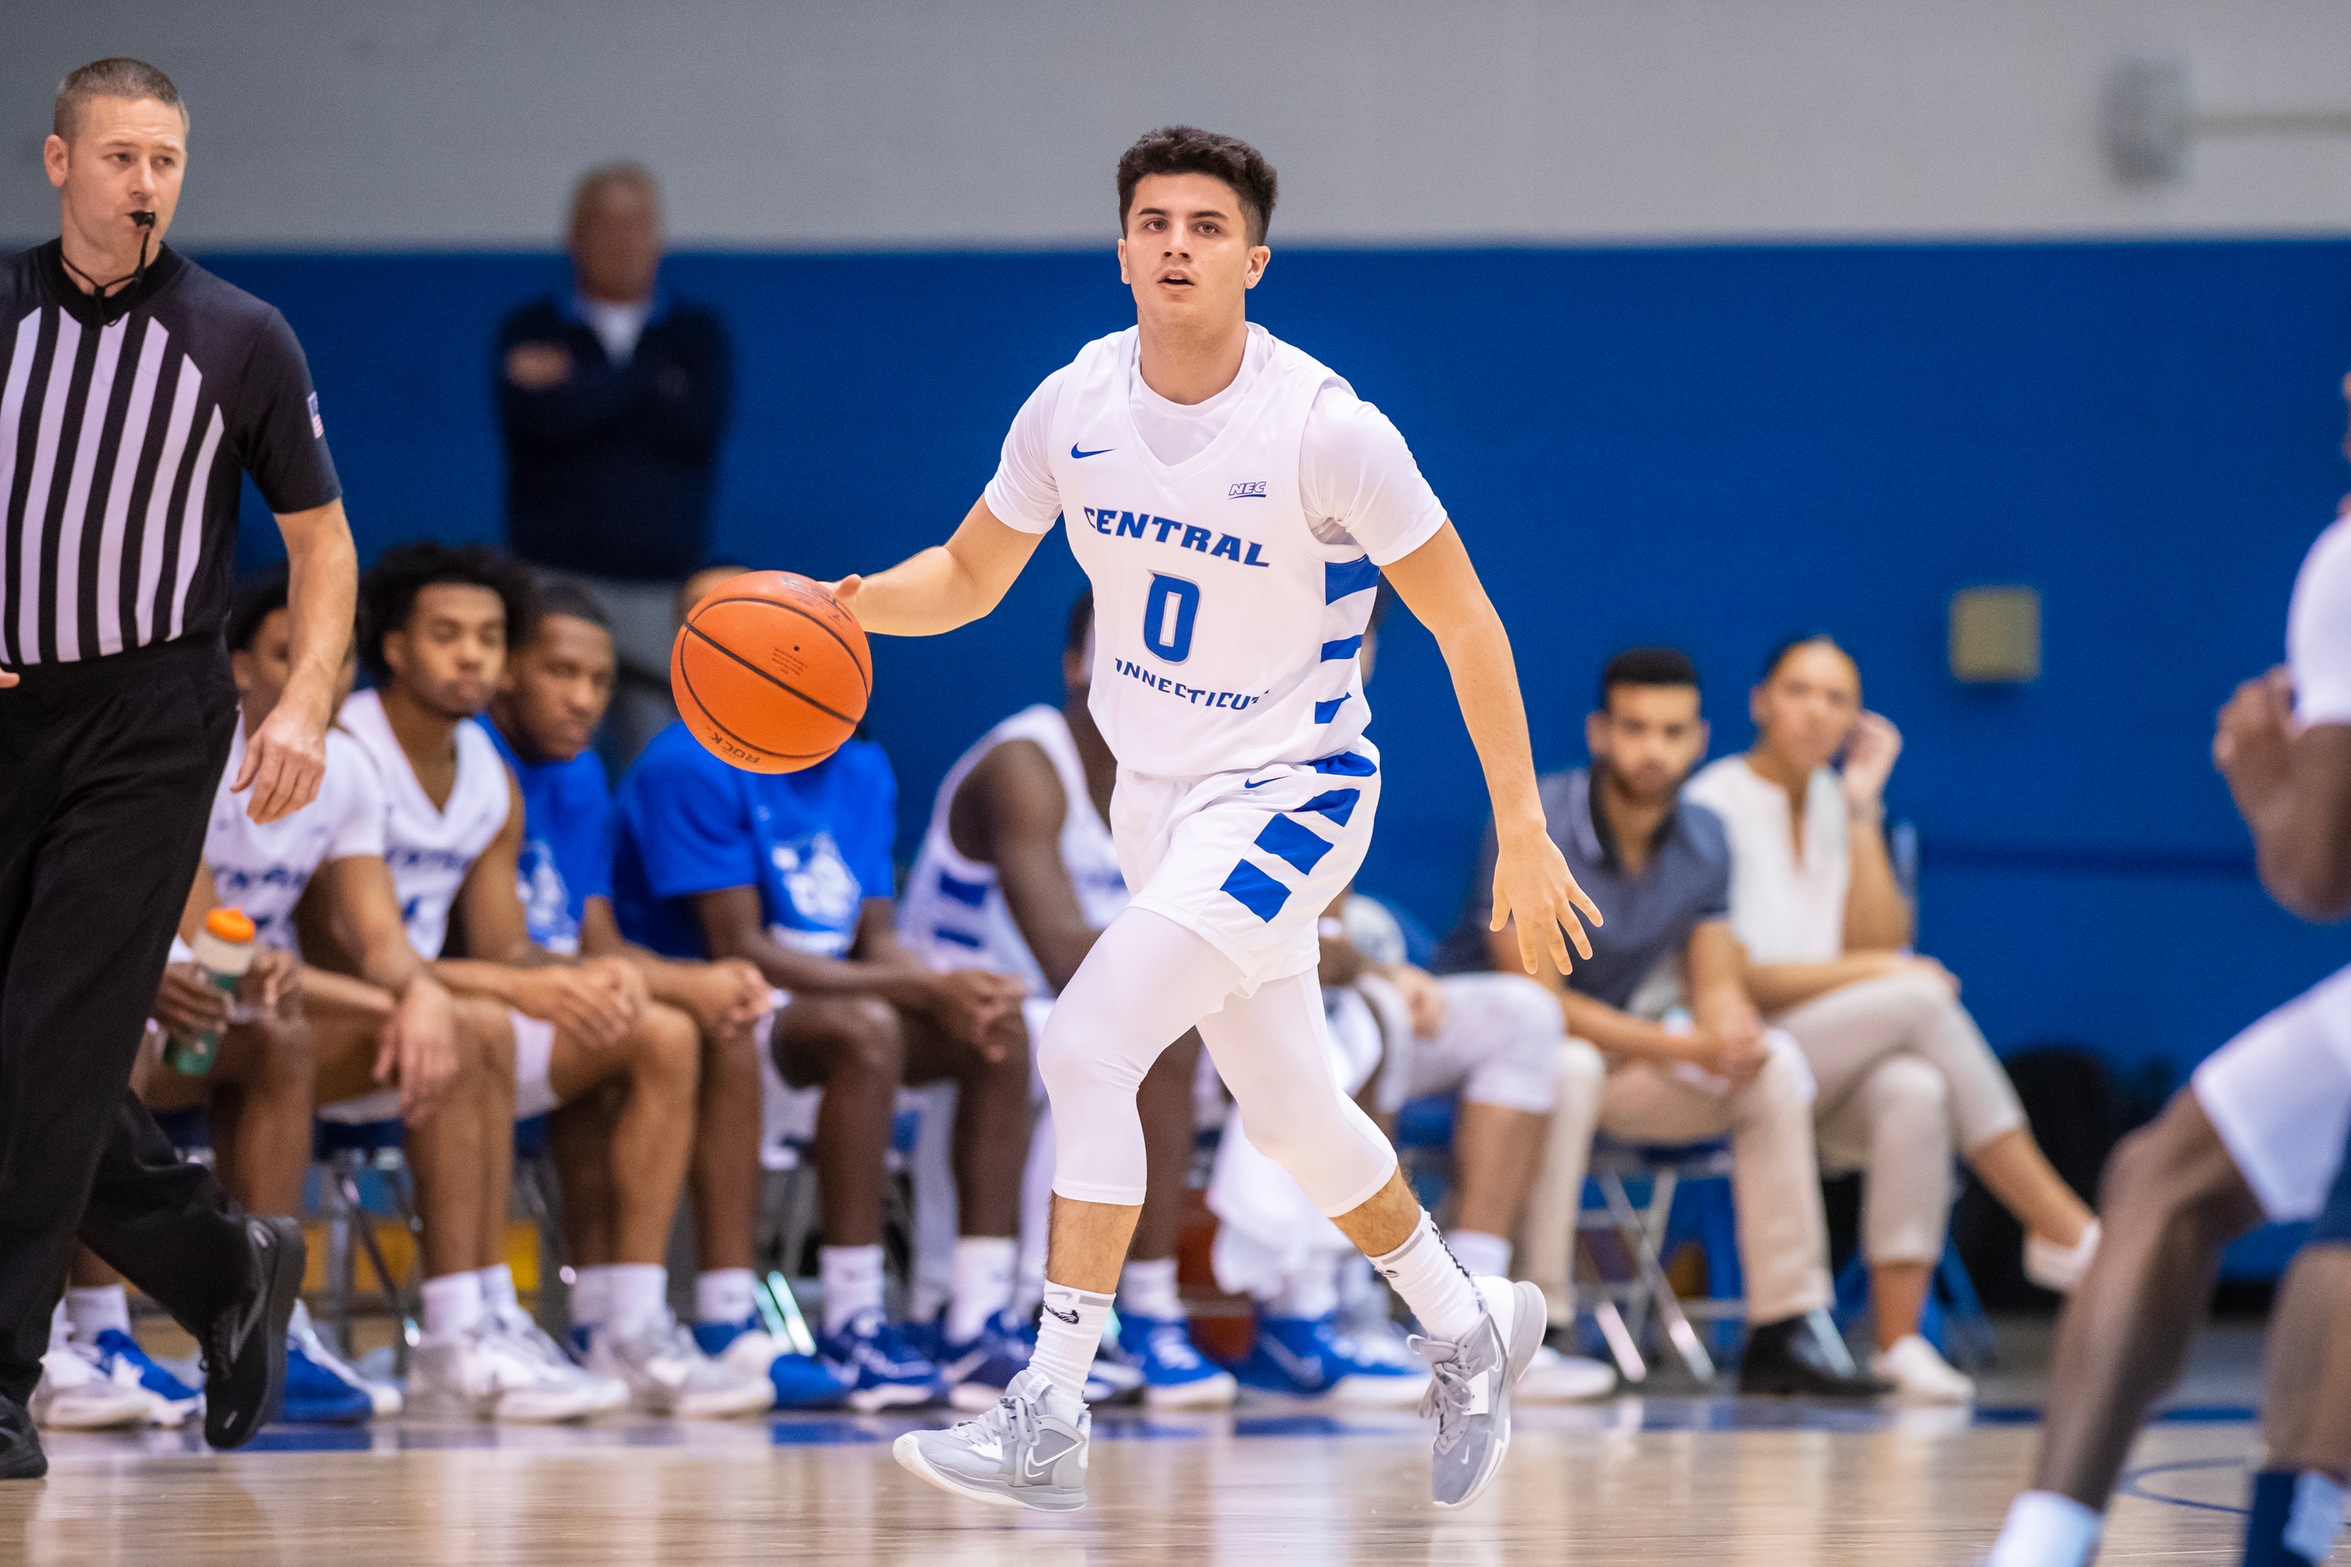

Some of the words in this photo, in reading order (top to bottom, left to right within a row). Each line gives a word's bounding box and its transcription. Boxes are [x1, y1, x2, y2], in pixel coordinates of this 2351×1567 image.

[1228, 480, 1267, 496] NEC
[1143, 569, 1203, 667] 0
[709, 731, 760, 764] ROCK
